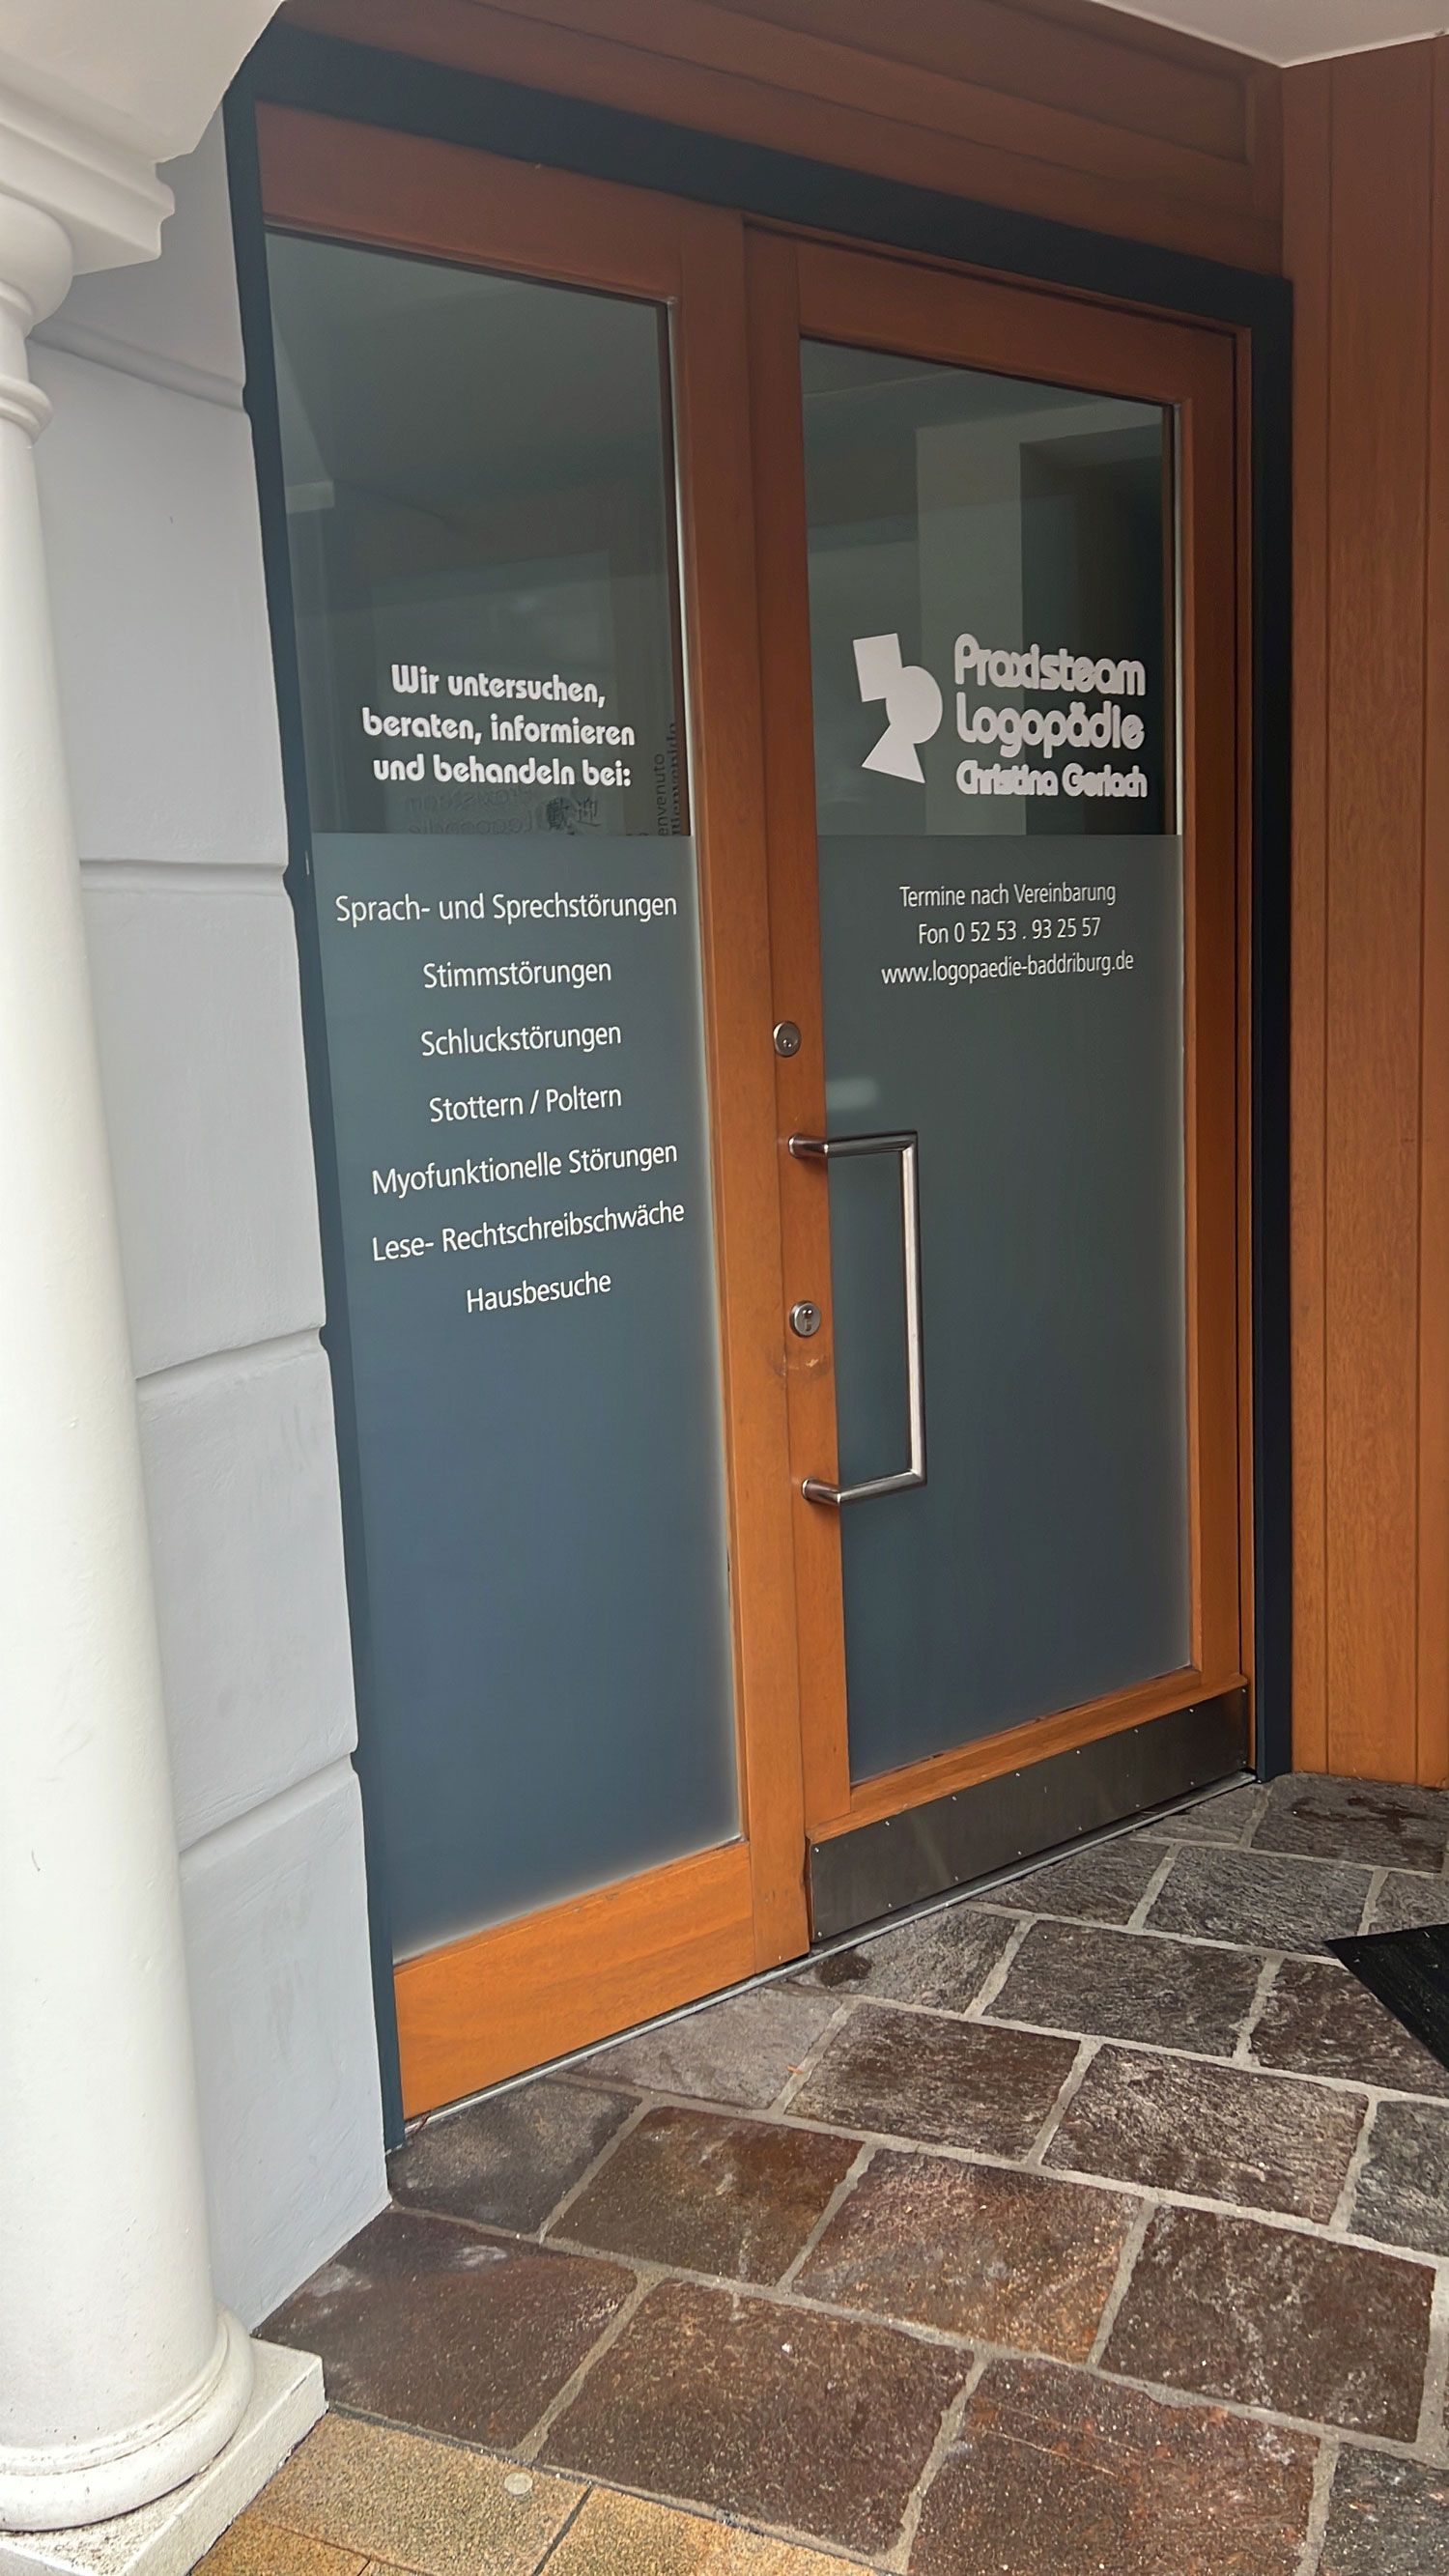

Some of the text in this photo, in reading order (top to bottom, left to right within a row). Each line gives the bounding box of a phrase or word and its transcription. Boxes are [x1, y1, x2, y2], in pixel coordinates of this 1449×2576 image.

[953, 633, 1146, 695] Praxisteam
[391, 664, 606, 709] Wir untersuchen,
[361, 706, 636, 746] beraten, informieren
[954, 692, 1146, 759] Logopädie
[373, 752, 631, 787] und behandeln bei:
[955, 759, 1148, 798] Christina Gerlach
[654, 753, 668, 836] envenuto
[335, 892, 677, 928] Sprach- und Sprechstörungen
[898, 881, 1116, 908] Termine nach Vereinbarung
[919, 923, 949, 945] Fon
[953, 921, 965, 943] 0
[971, 920, 991, 943] 52
[996, 920, 1017, 941] 53
[1032, 919, 1052, 940] 93
[1057, 918, 1077, 939] 25
[1082, 917, 1101, 937] 57
[423, 960, 611, 989] Stimmstörungen
[881, 949, 1134, 986] www.logopaedie-baddriburg.de
[420, 1025, 621, 1057] Schluckstörungen
[429, 1085, 622, 1123] Stottern / Poltern
[372, 1145, 678, 1199] Myofunktionelle Störungen
[372, 1200, 685, 1261] Lese- Rechtschreibschwäche
[467, 1270, 611, 1314] Hausbesuche
